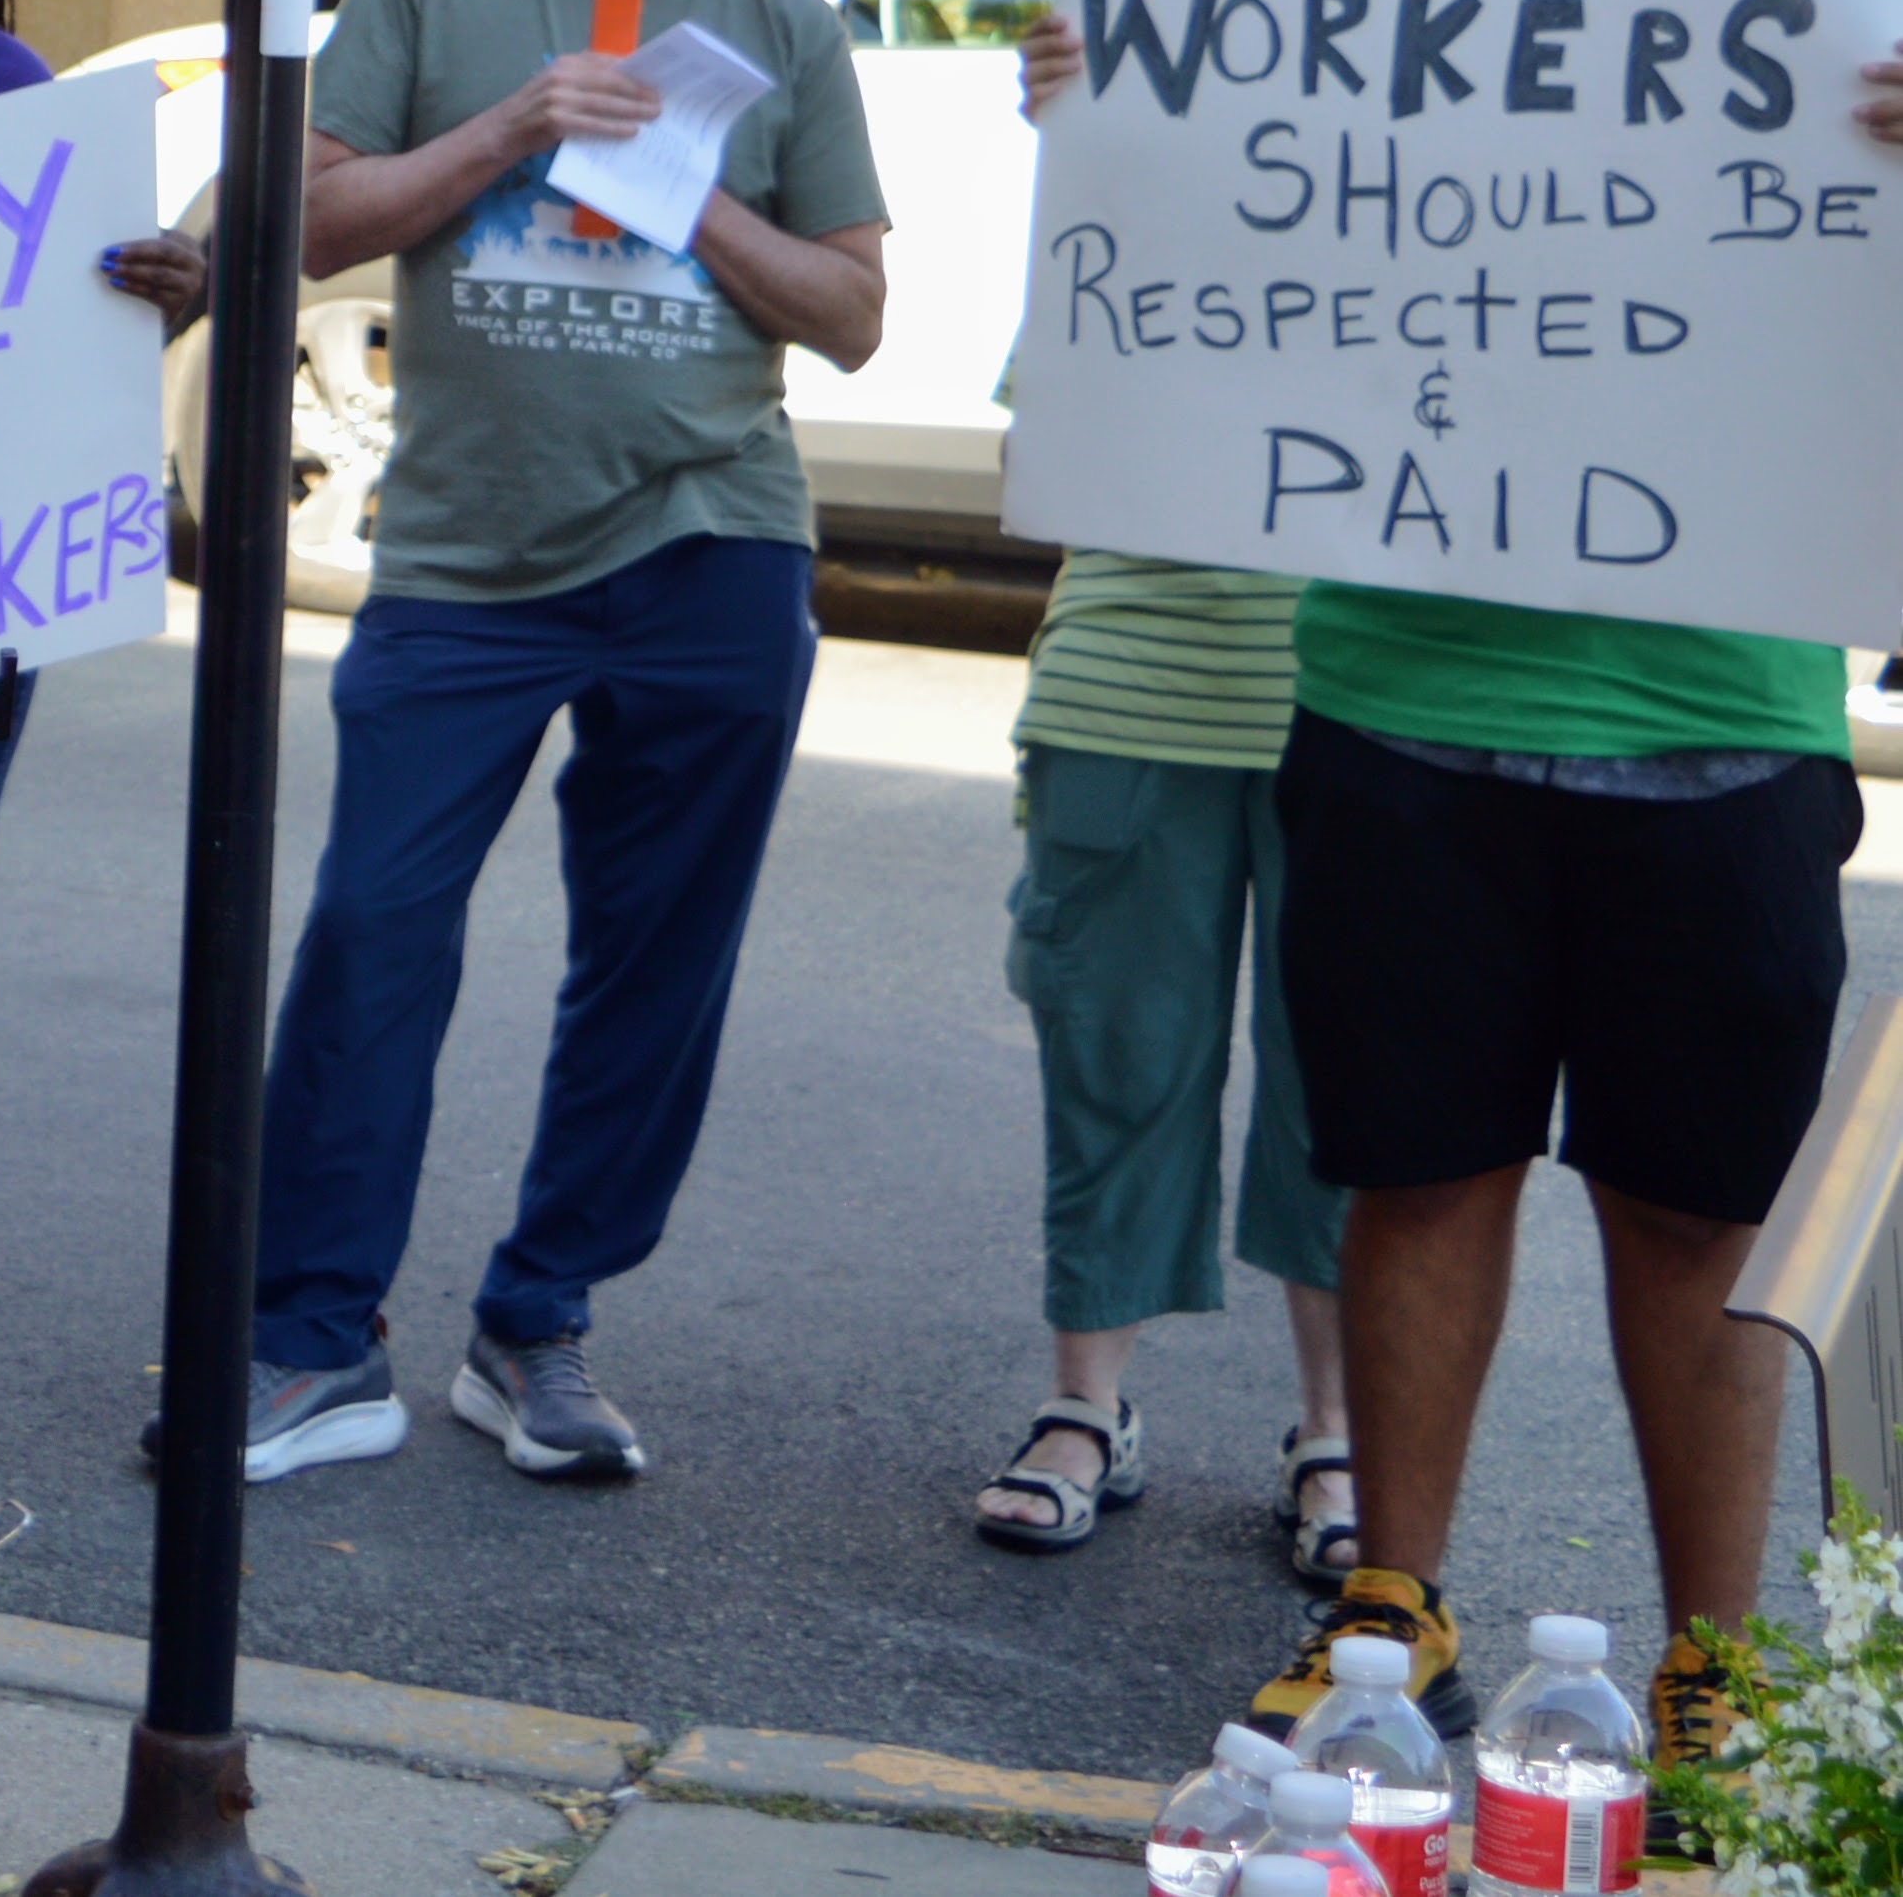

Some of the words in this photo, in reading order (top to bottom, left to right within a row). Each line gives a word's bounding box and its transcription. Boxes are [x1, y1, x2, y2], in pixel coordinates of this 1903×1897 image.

[1236, 121, 1658, 260] SHOULD
[1709, 160, 1879, 243] BE
[451, 280, 716, 331] EXPLORE
[1051, 223, 1691, 357] RESPECTED
[454, 313, 507, 332] YMCA
[516, 318, 551, 334] OF
[559, 320, 611, 339] THE
[621, 327, 715, 351] ROCKIES
[487, 331, 556, 349] ESTES
[650, 345, 678, 360] CO
[1413, 360, 1456, 441] &
[1263, 428, 1678, 566] PAID
